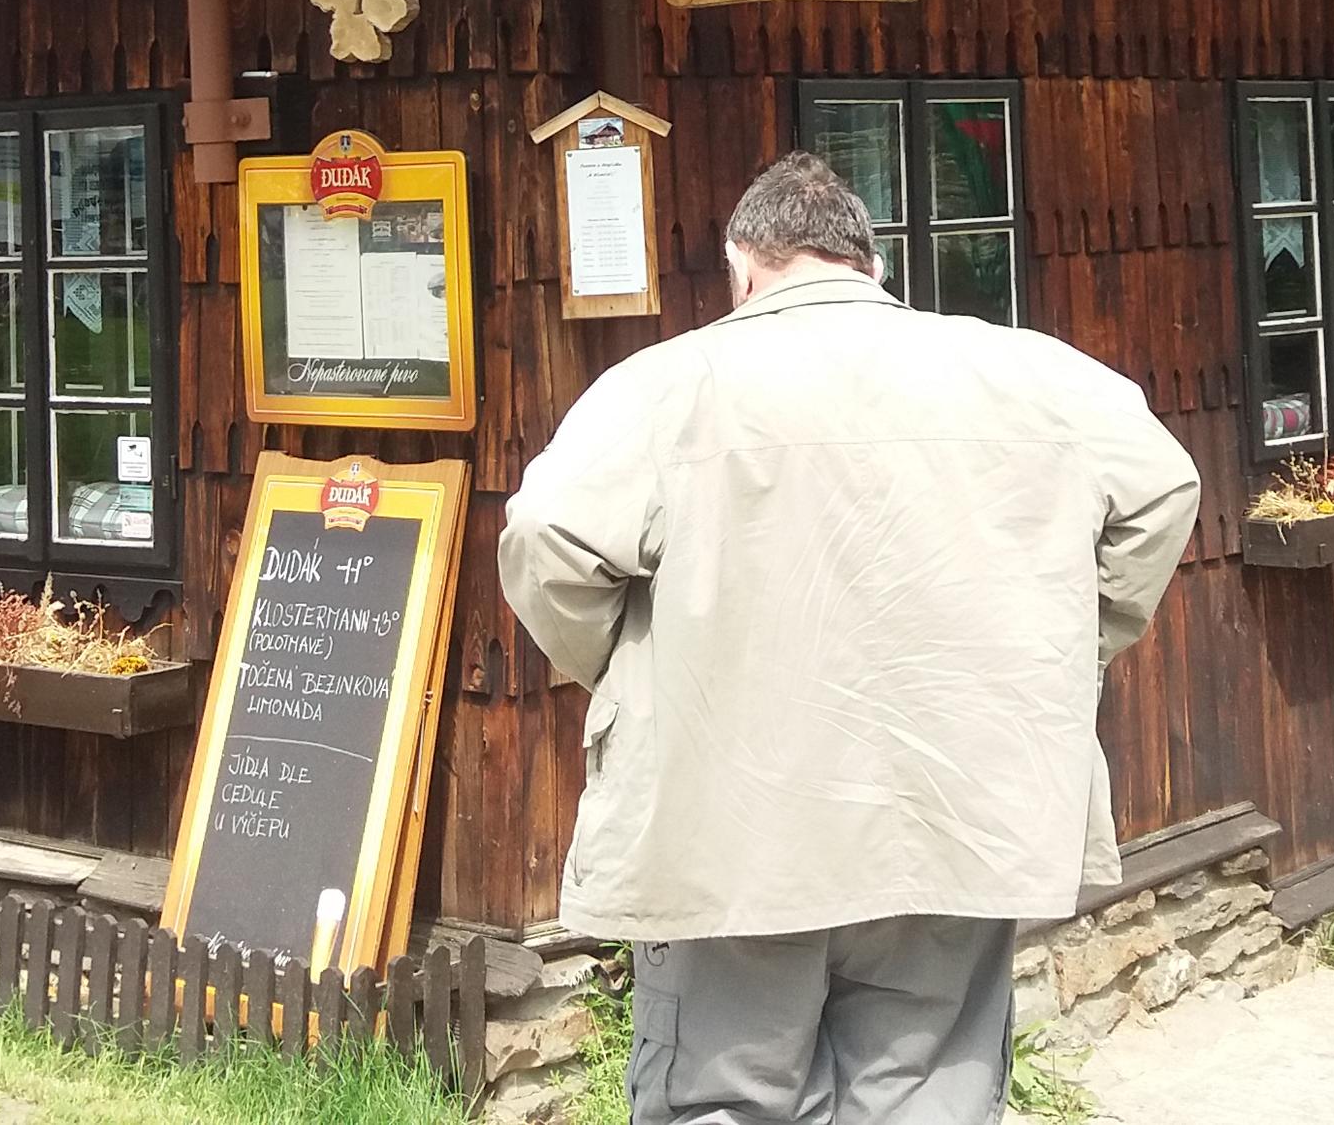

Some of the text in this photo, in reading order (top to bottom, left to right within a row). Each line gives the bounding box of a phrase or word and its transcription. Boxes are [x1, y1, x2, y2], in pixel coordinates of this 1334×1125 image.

[320, 163, 372, 189] DUDÁK
[287, 357, 419, 394] Nepasterované pivo
[327, 484, 372, 507] DUDÁK
[258, 538, 323, 584] DUDÁK
[251, 597, 370, 635] KLOSTERMANN
[239, 659, 397, 700] TOČENÁ BEZINKOVÁ
[246, 694, 323, 722] LIMONÁDA
[228, 745, 313, 784] JÍDLA DLE
[221, 783, 284, 810] CEDULE
[214, 812, 226, 831] U
